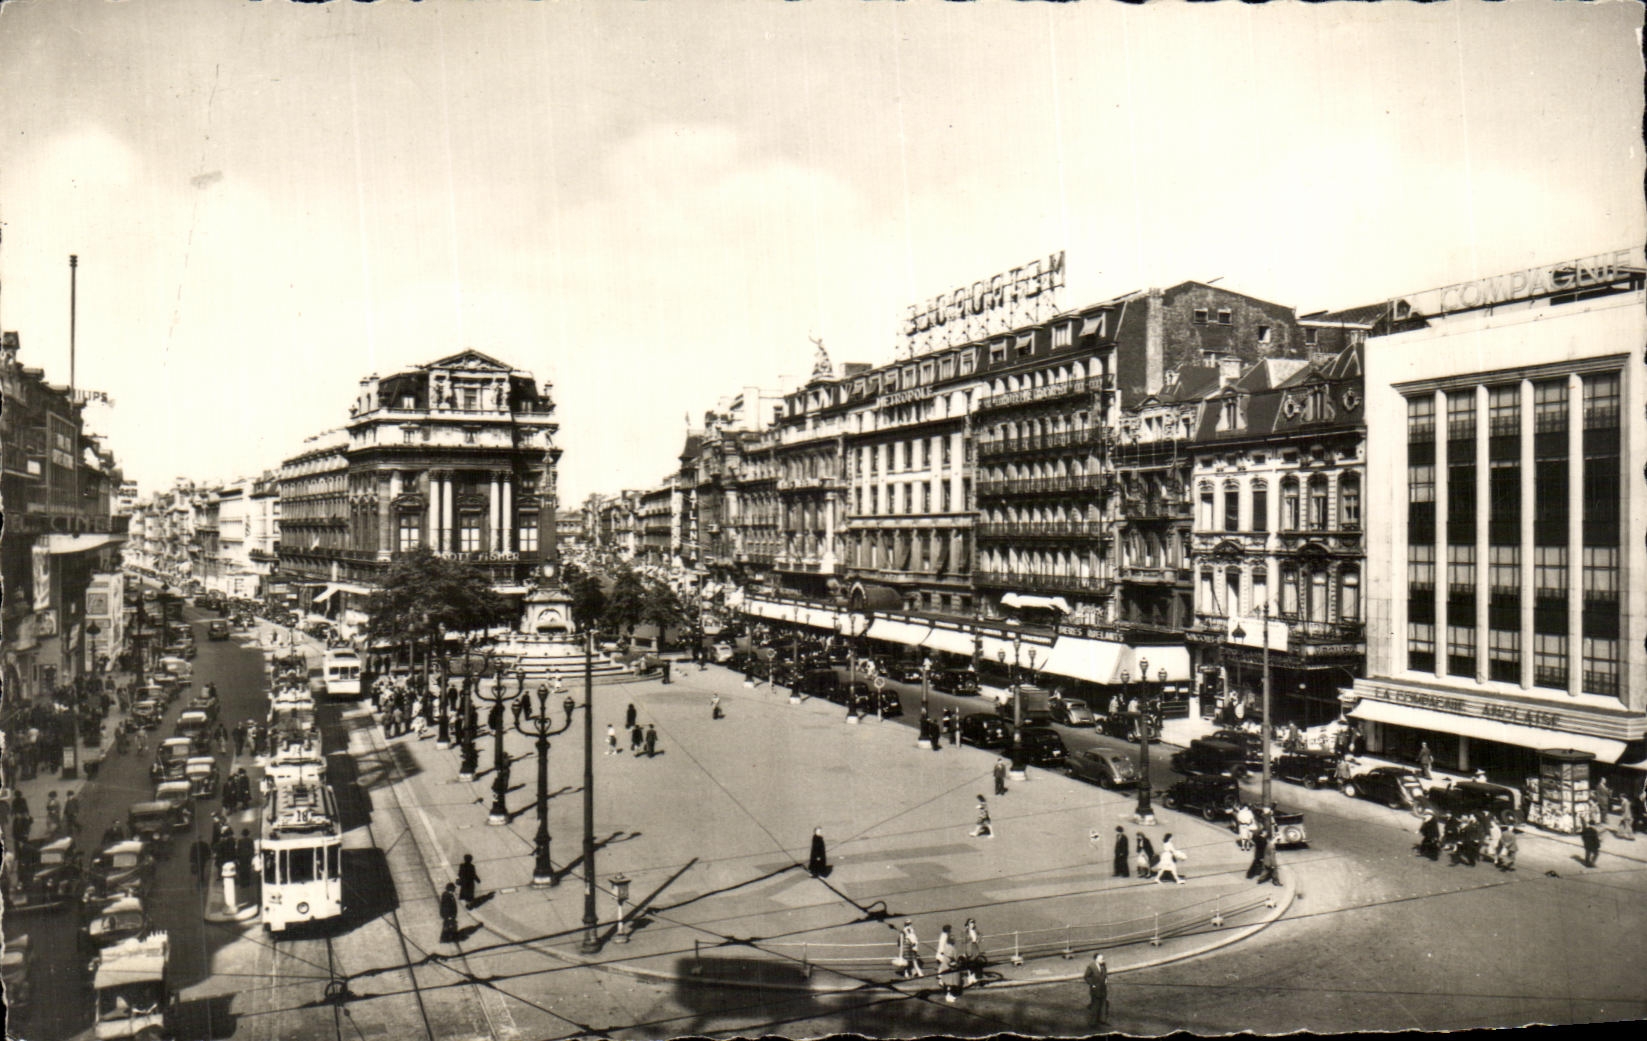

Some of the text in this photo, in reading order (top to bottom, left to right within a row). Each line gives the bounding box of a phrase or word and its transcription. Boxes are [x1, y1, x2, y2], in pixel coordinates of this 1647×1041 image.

[1393, 250, 1631, 321] LA COMPAGNIE
[877, 386, 934, 408] METROPOLE
[689, 489, 698, 560] ATLANTA
[1374, 687, 1561, 728] LA COMPAGNIE ANGLAISE
